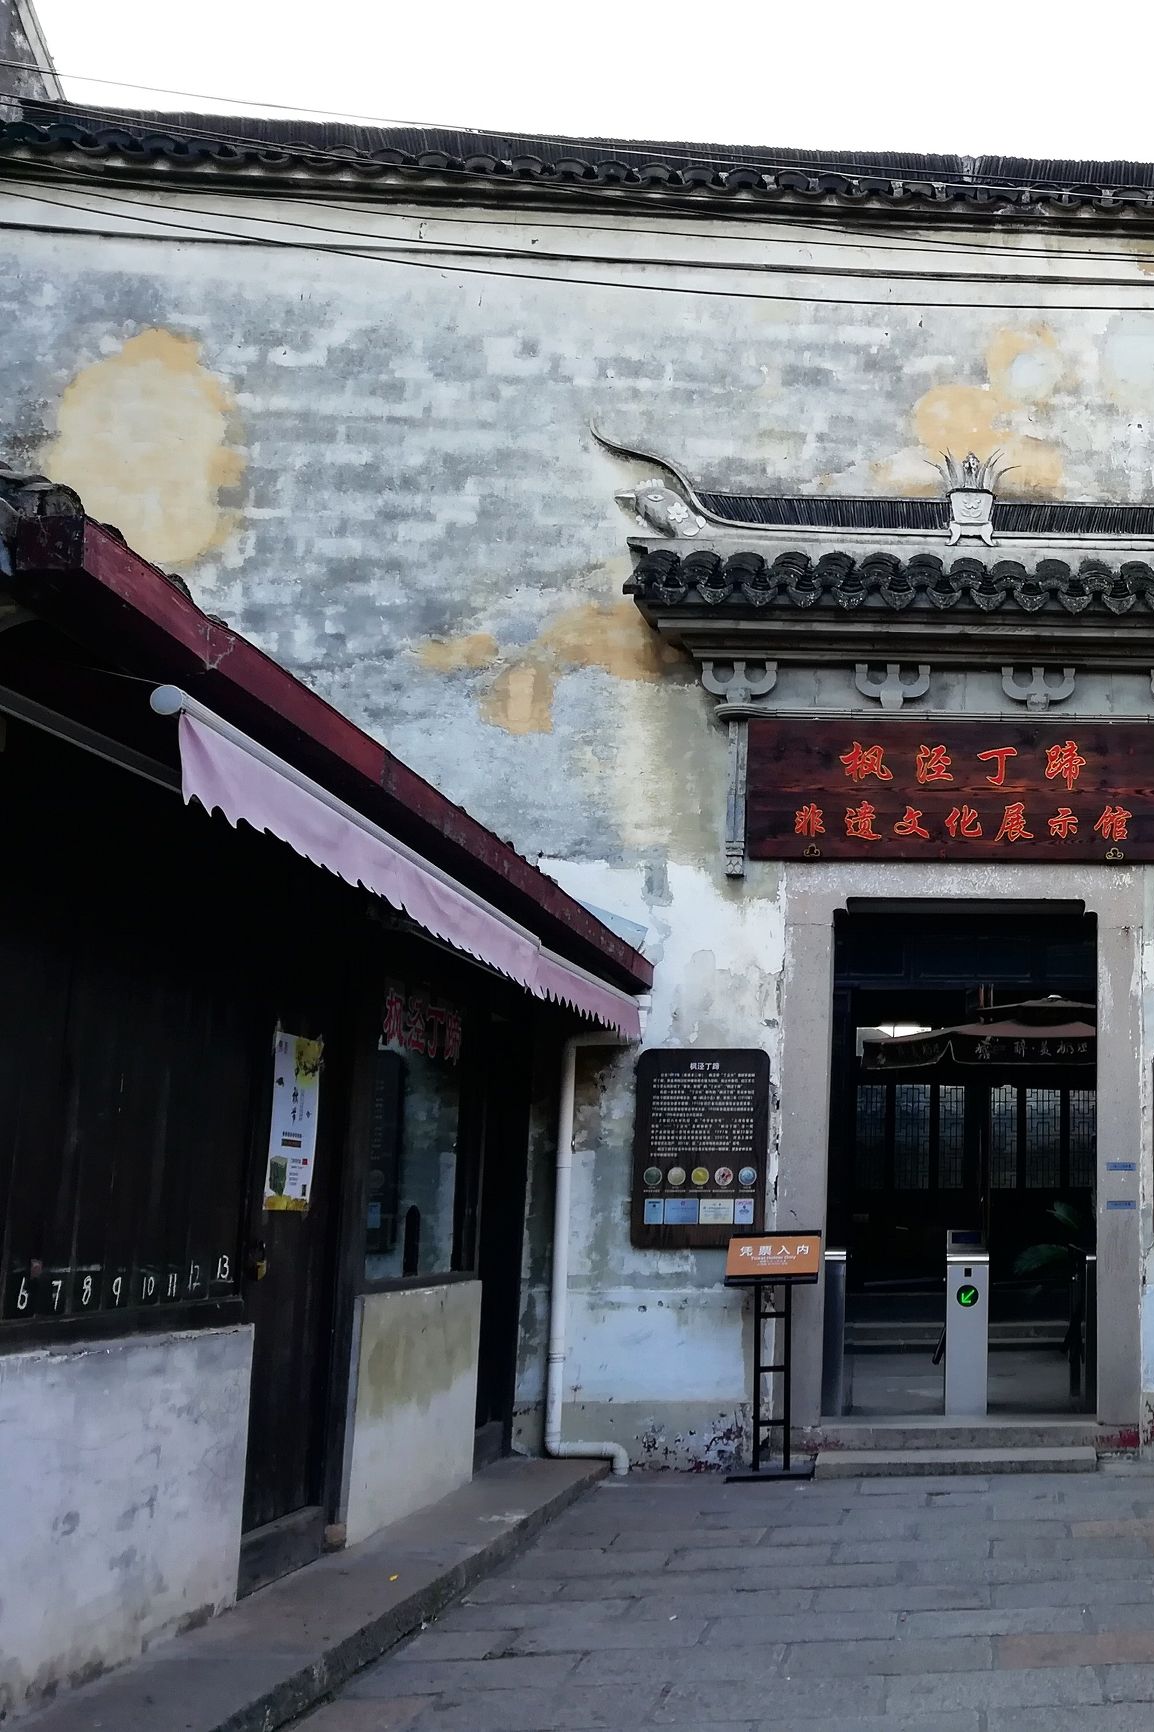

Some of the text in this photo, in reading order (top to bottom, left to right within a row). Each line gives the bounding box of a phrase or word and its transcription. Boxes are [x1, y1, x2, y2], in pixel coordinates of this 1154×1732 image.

[838, 740, 1088, 792] 枫泾丁蹄
[793, 801, 1134, 843] 非遗文化展示馆
[740, 1243, 810, 1257] 凭票入内
[16, 1254, 231, 1311] 6 7 8 9 10 11 12 13
